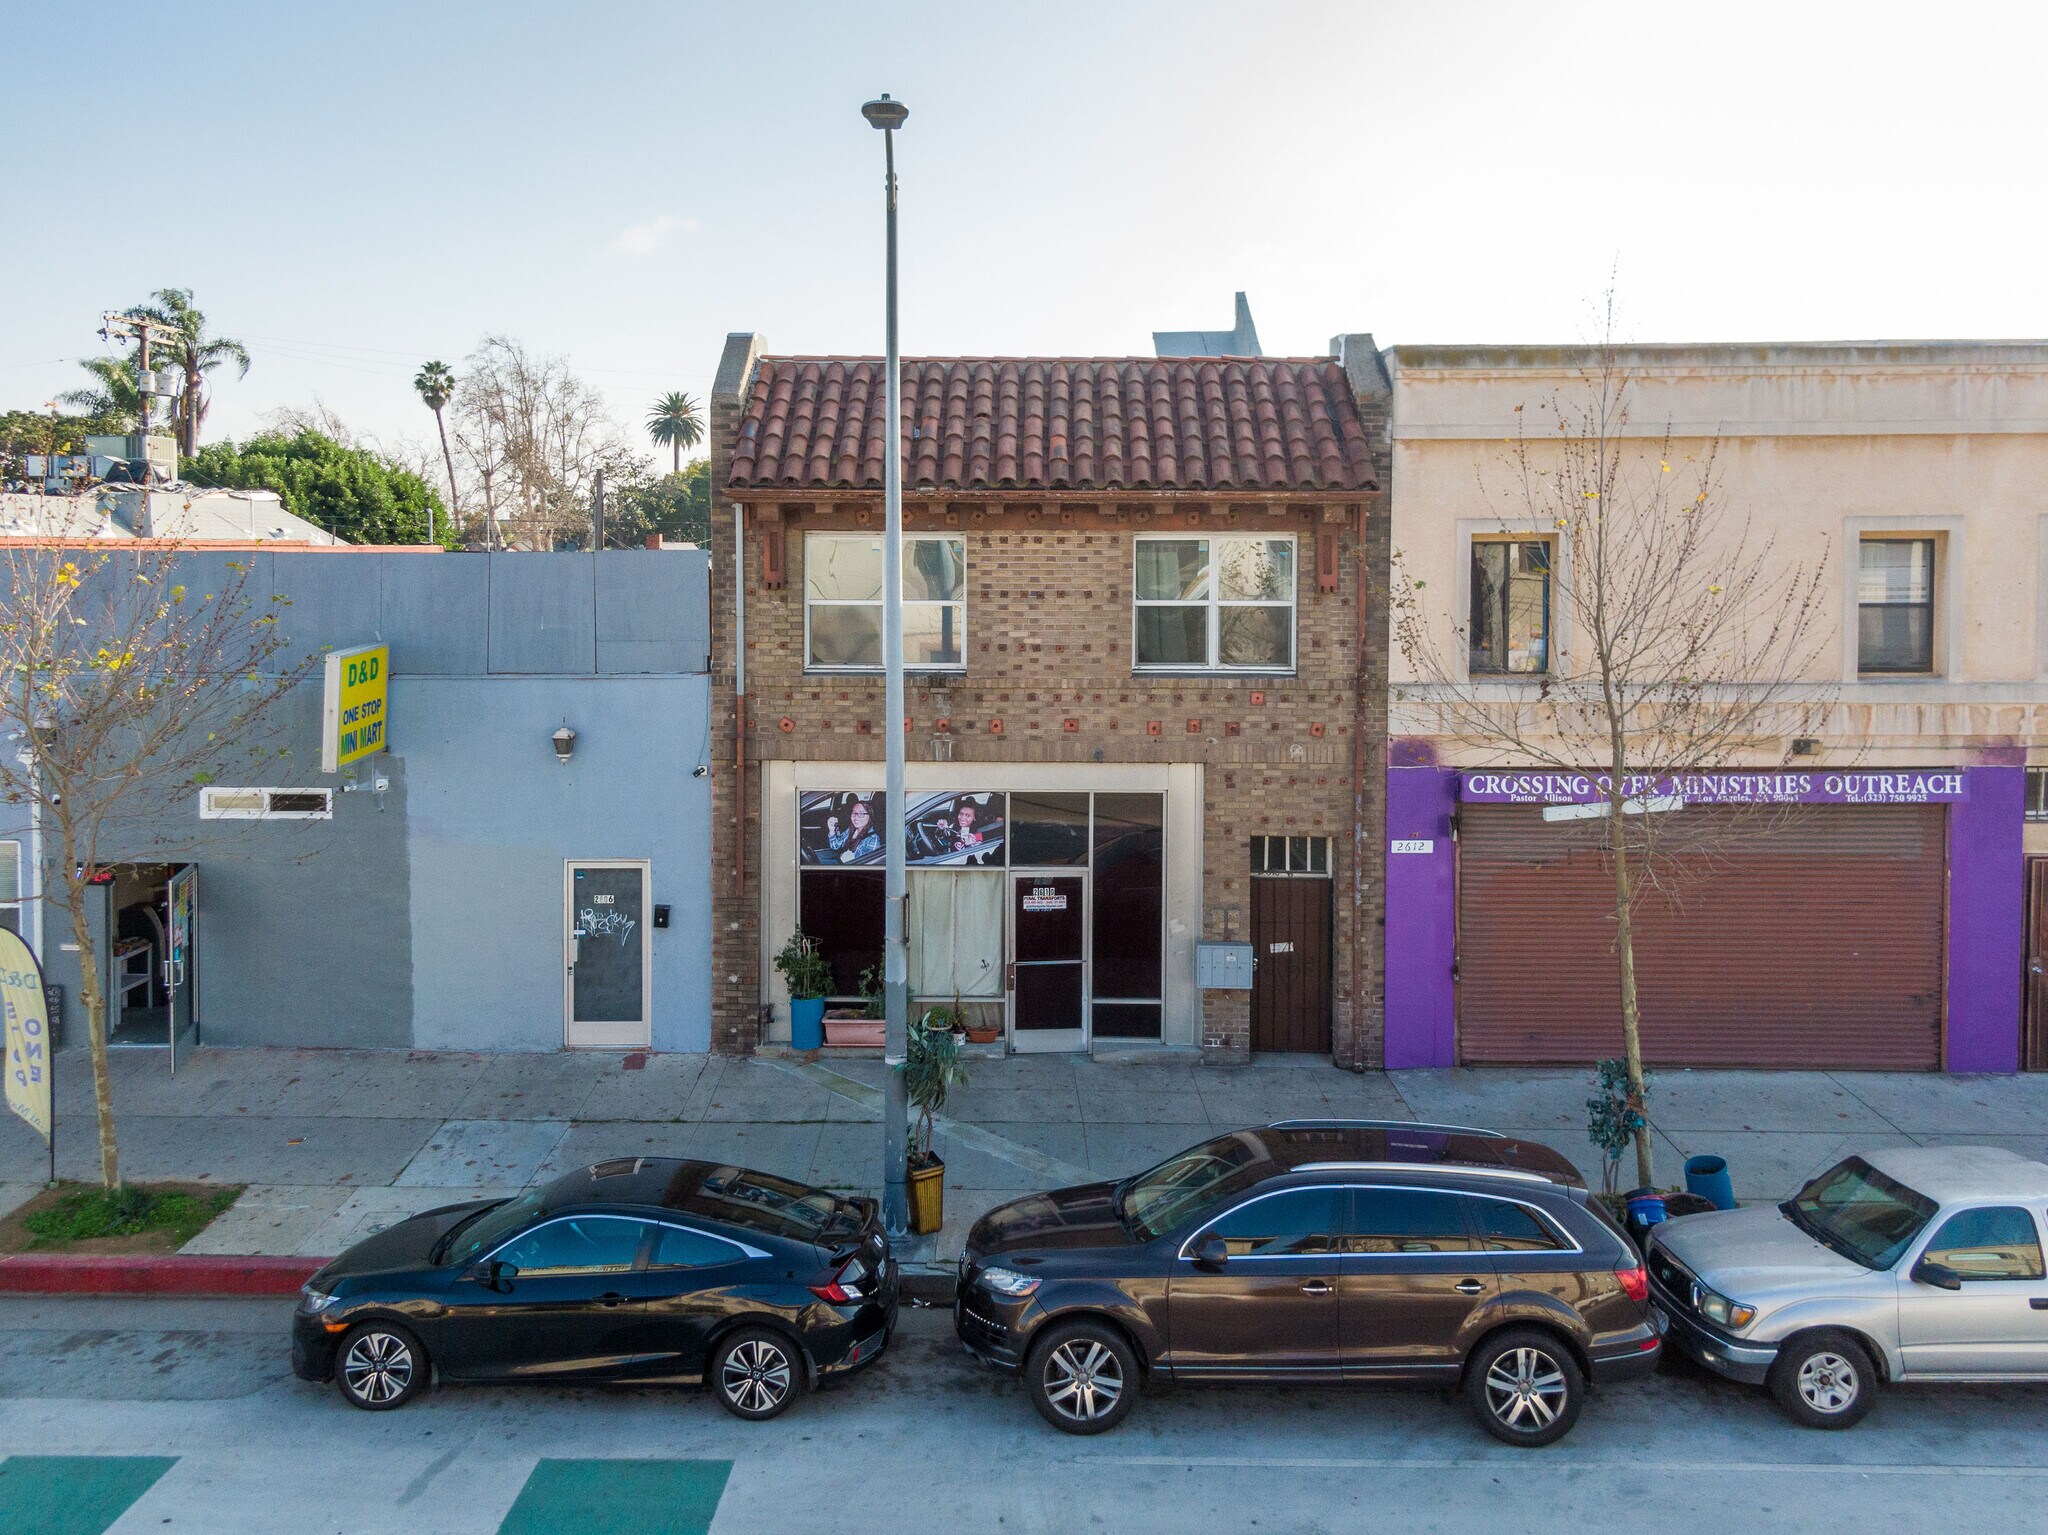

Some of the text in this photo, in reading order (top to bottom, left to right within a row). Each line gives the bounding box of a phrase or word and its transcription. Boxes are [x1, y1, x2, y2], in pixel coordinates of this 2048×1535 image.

[348, 657, 379, 688] D&D
[343, 698, 382, 726] ONE STOP
[341, 720, 383, 757] MINI MART
[1468, 775, 1590, 795] CROSSING
[1670, 774, 1811, 795] MINISTRIES
[1825, 774, 1963, 795] OUTREACH
[1510, 794, 1537, 802] Pastor
[1543, 794, 1573, 802] Allison
[1889, 794, 1905, 802] 750
[1906, 794, 1928, 802] 9925
[1397, 842, 1425, 851] 2612
[1033, 888, 1055, 896] 2610
